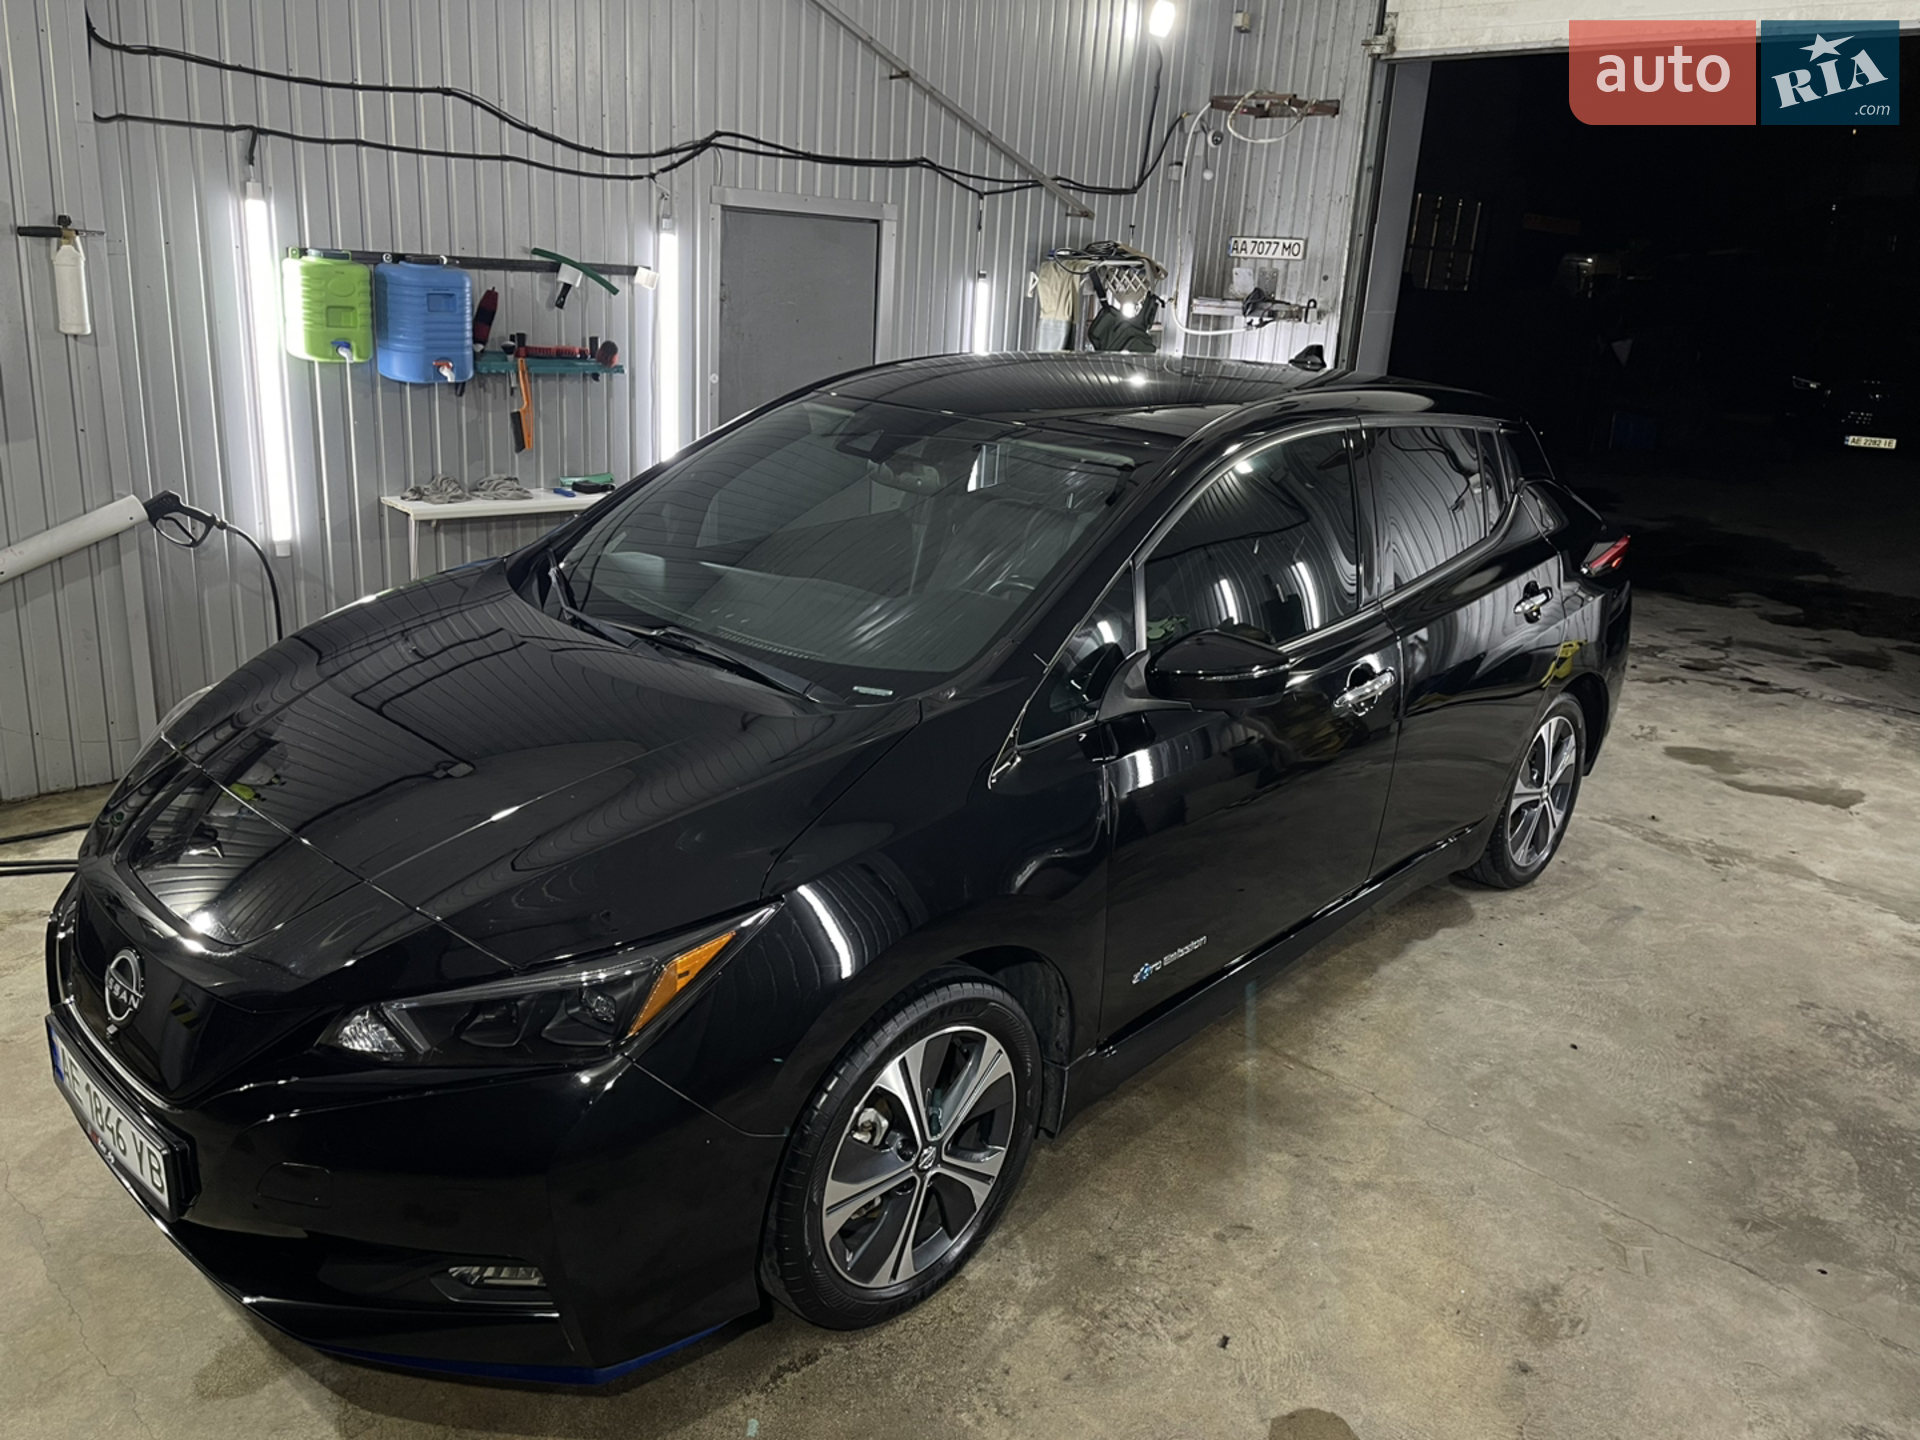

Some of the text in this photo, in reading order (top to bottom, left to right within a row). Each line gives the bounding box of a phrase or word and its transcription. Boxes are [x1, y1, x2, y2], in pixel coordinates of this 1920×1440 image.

[1232, 240, 1301, 257] AA 7077 MO
[104, 964, 141, 1009] SSAN
[61, 1046, 84, 1107] AE
[85, 1082, 127, 1158] 1846
[131, 1130, 165, 1194] YB
